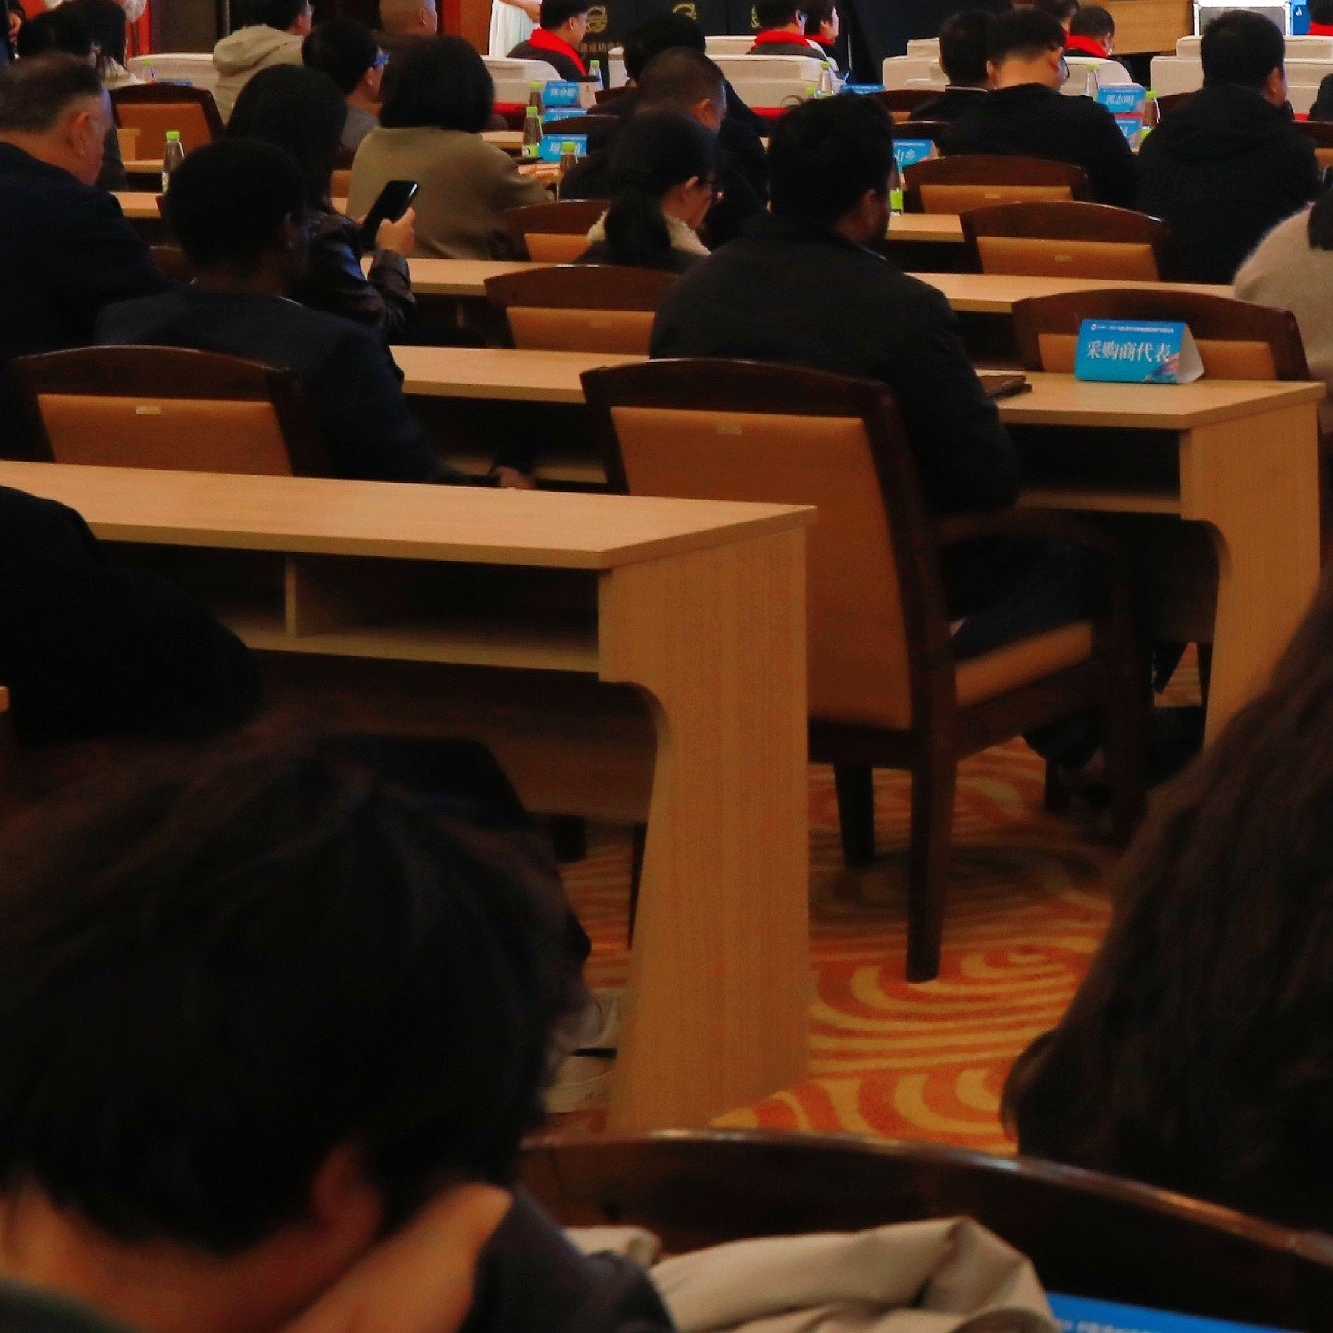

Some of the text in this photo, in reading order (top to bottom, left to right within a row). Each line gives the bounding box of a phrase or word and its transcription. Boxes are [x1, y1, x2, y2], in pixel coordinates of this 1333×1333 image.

[1086, 339, 1172, 363] 采购商代表
